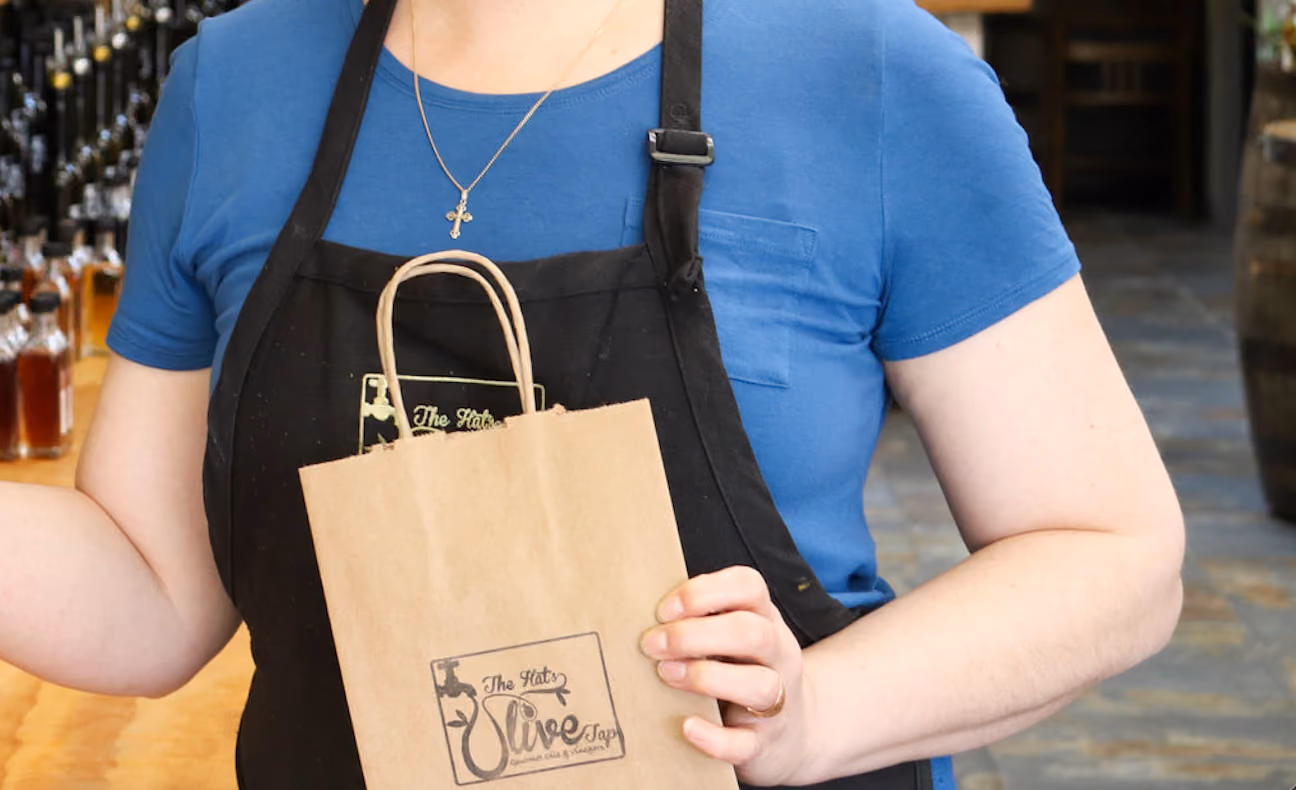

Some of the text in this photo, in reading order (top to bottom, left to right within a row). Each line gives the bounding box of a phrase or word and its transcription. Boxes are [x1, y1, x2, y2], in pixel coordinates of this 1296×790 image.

[413, 404, 450, 428] The
[481, 673, 515, 694] The
[461, 693, 617, 780] Olive Tap
